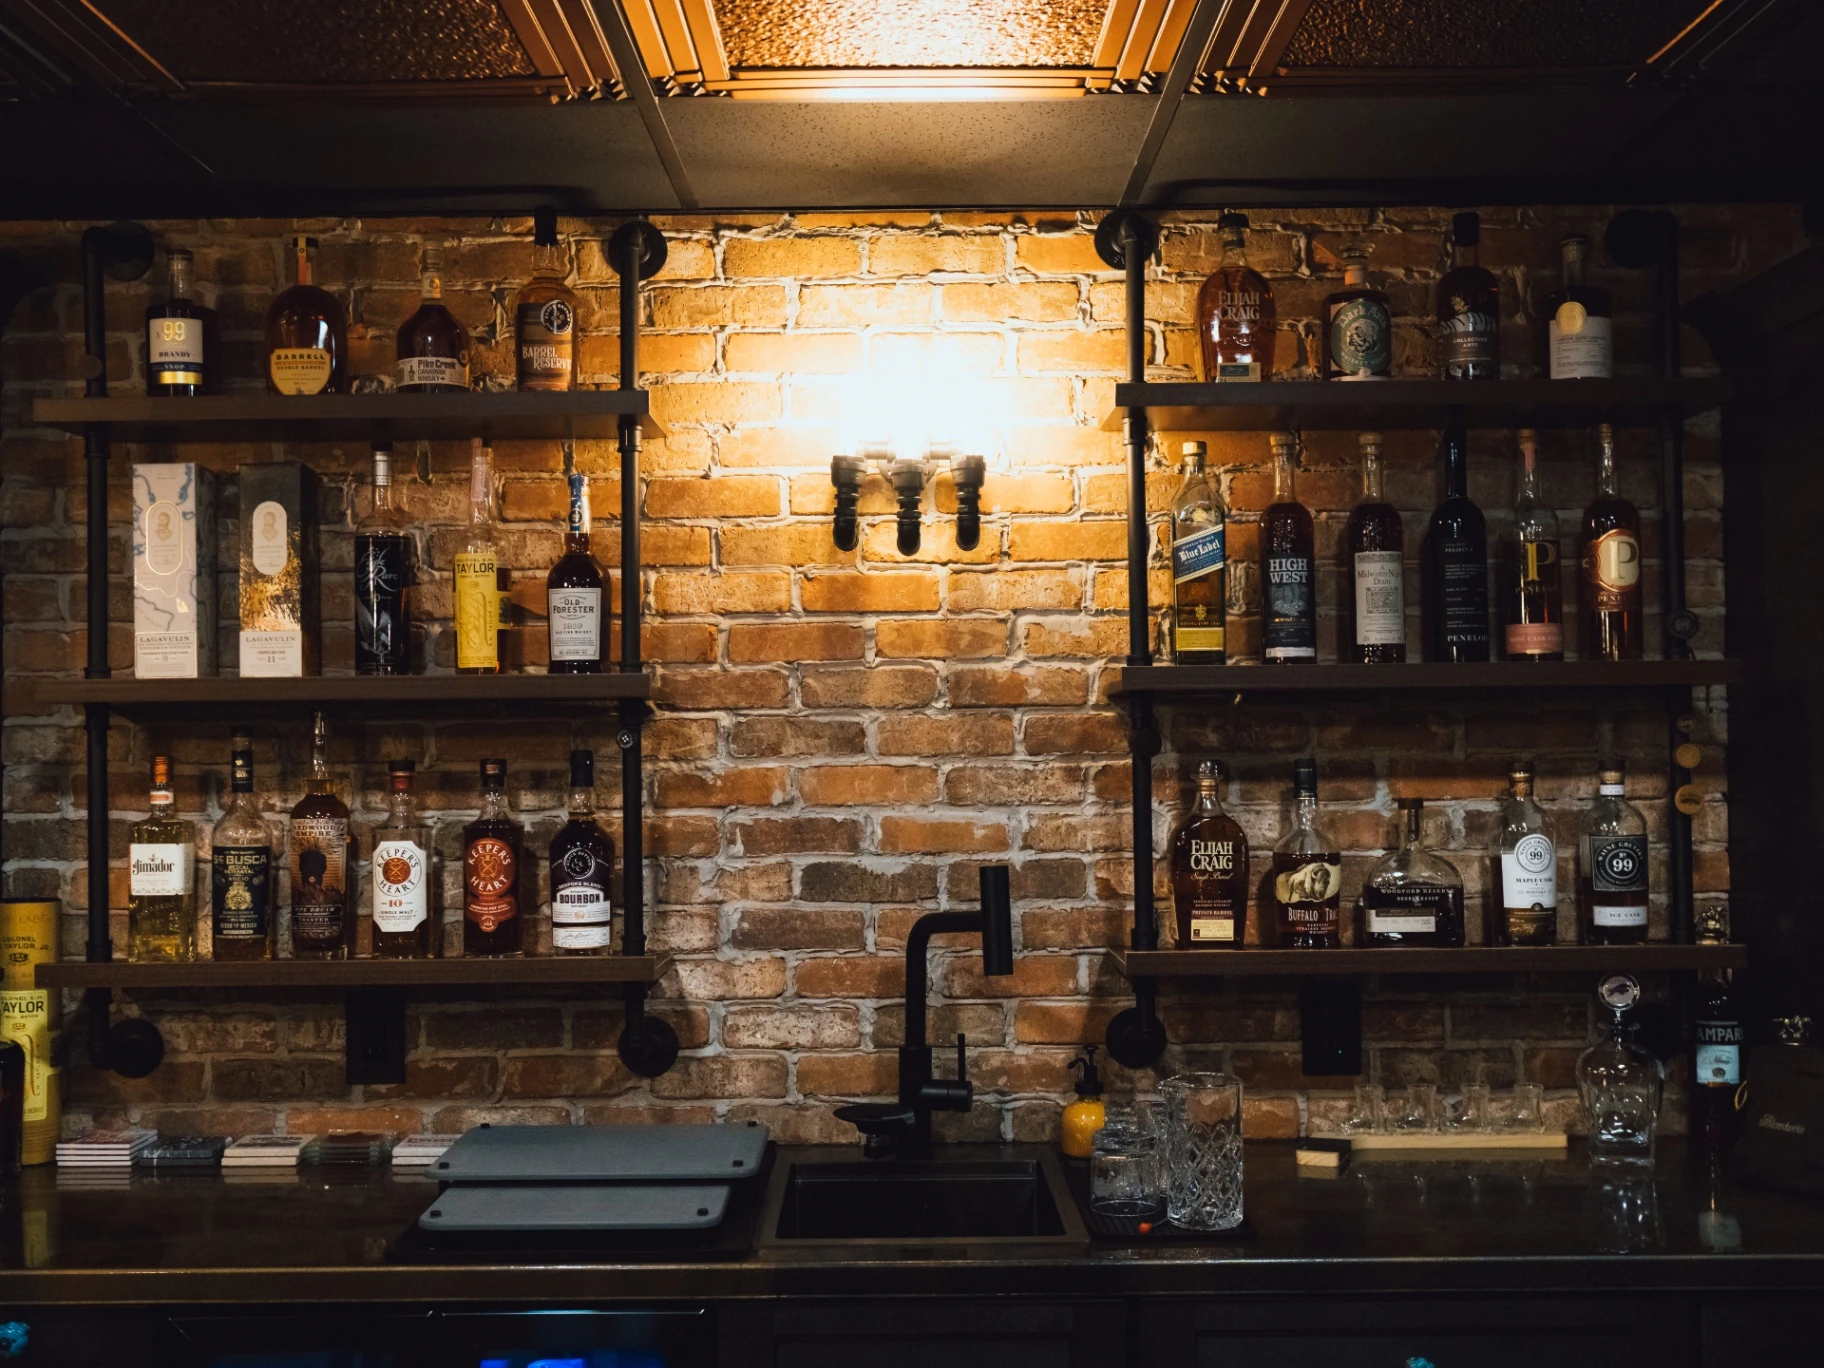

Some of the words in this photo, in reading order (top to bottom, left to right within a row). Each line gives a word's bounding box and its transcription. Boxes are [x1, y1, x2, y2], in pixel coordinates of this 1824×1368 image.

[1218, 286, 1260, 305] ELIJAH
[1217, 304, 1260, 321] CRAIG
[1336, 304, 1367, 328] Dark
[162, 321, 187, 341] 99
[522, 346, 558, 359] BARREL
[1178, 549, 1199, 563] Blue
[1197, 539, 1221, 556] Label
[456, 562, 495, 574] TAYLOR
[1269, 558, 1308, 571] HIGH
[1525, 542, 1556, 580] P
[1610, 541, 1638, 579] P
[1269, 571, 1308, 583] WEST
[553, 605, 595, 614] FORESTER
[468, 844, 511, 866] KEEPER'S
[1190, 840, 1233, 855] ELIJAH
[1529, 851, 1543, 860] 99
[1597, 843, 1616, 861] WAYNE
[213, 855, 225, 865] SE
[226, 855, 267, 865] BUSCA
[376, 848, 419, 869] KEEPER'S
[1190, 855, 1233, 872] CRAIG
[1612, 858, 1633, 872] 99
[379, 879, 416, 894] HEART
[470, 874, 508, 891] HEART
[559, 894, 601, 904] BOURBON
[1287, 907, 1319, 922] BUFFALO
